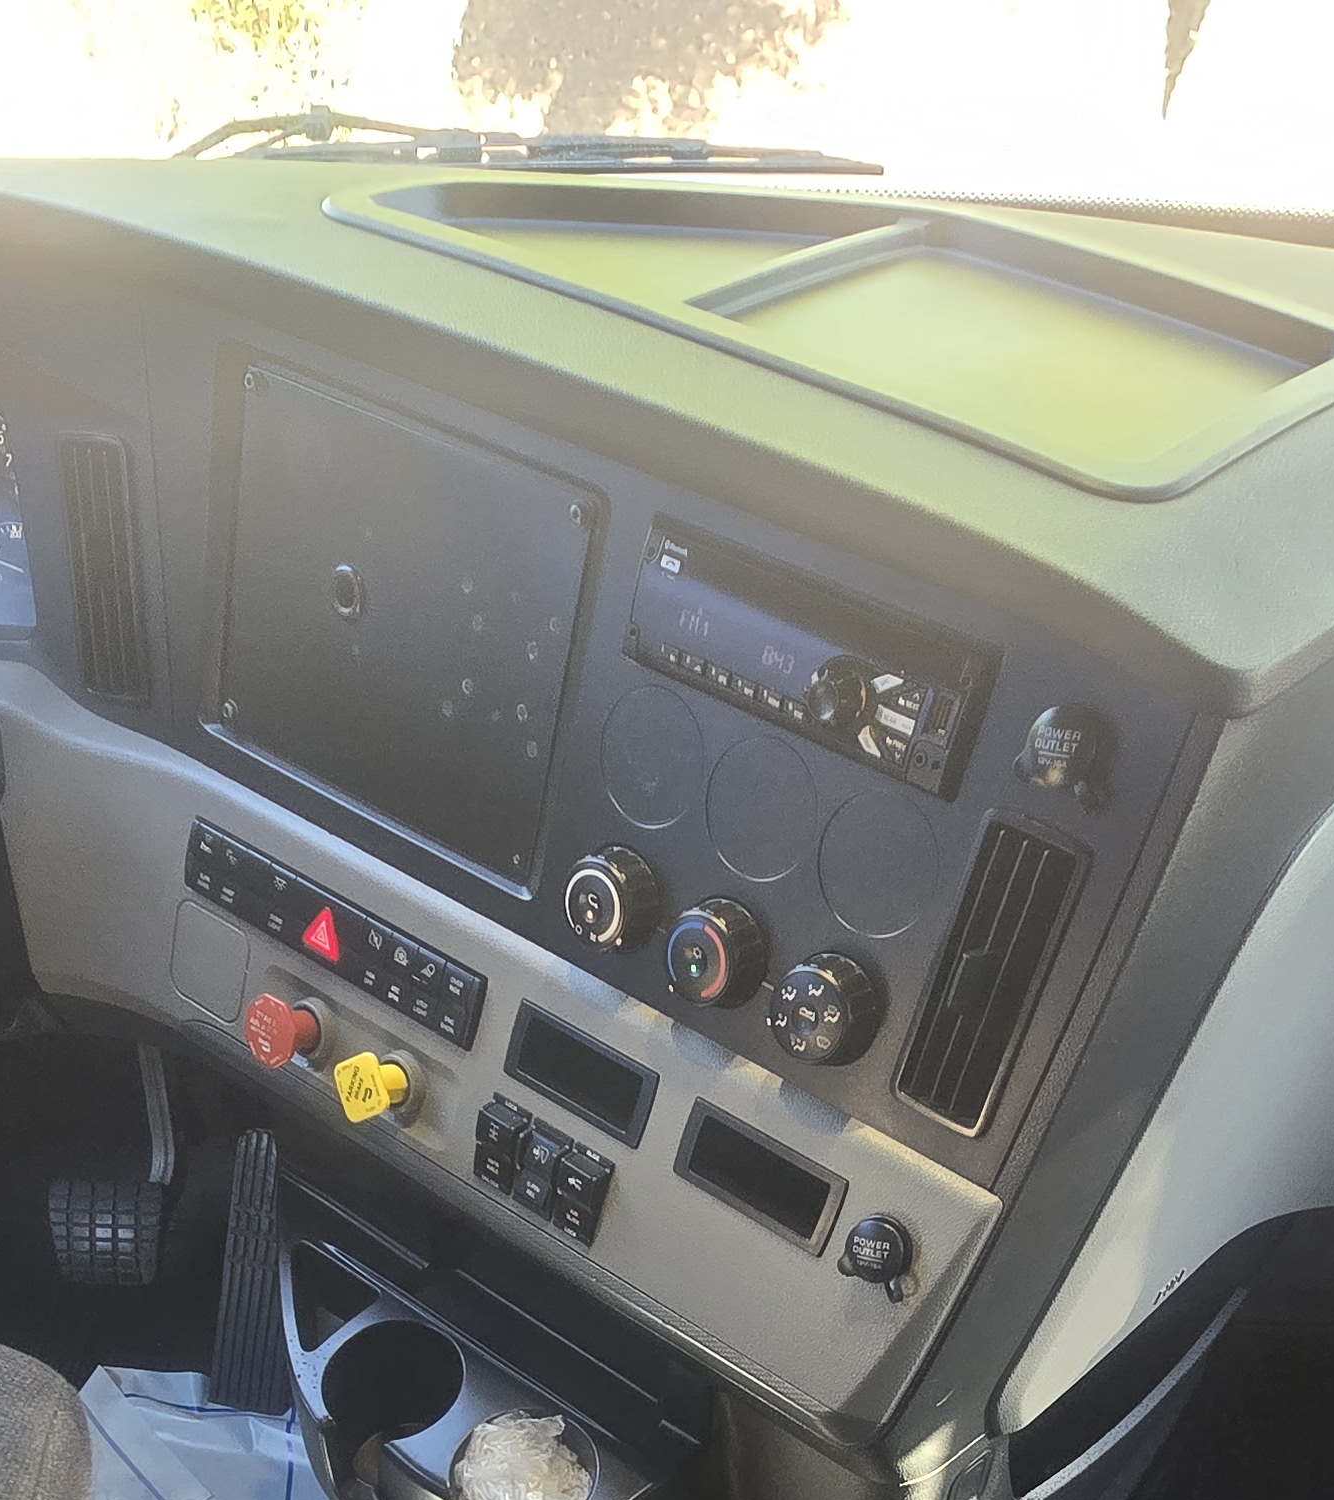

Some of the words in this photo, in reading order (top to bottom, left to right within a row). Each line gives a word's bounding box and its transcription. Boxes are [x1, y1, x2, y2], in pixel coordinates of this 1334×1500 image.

[5, 454, 13, 467] 7
[1037, 725, 1082, 741] POWER
[1034, 737, 1079, 754] OUTLET
[346, 1065, 360, 1103] PARKING
[354, 1077, 364, 1100] BRAKE
[854, 1236, 890, 1250] POWER
[852, 1245, 889, 1259] OUTLET
